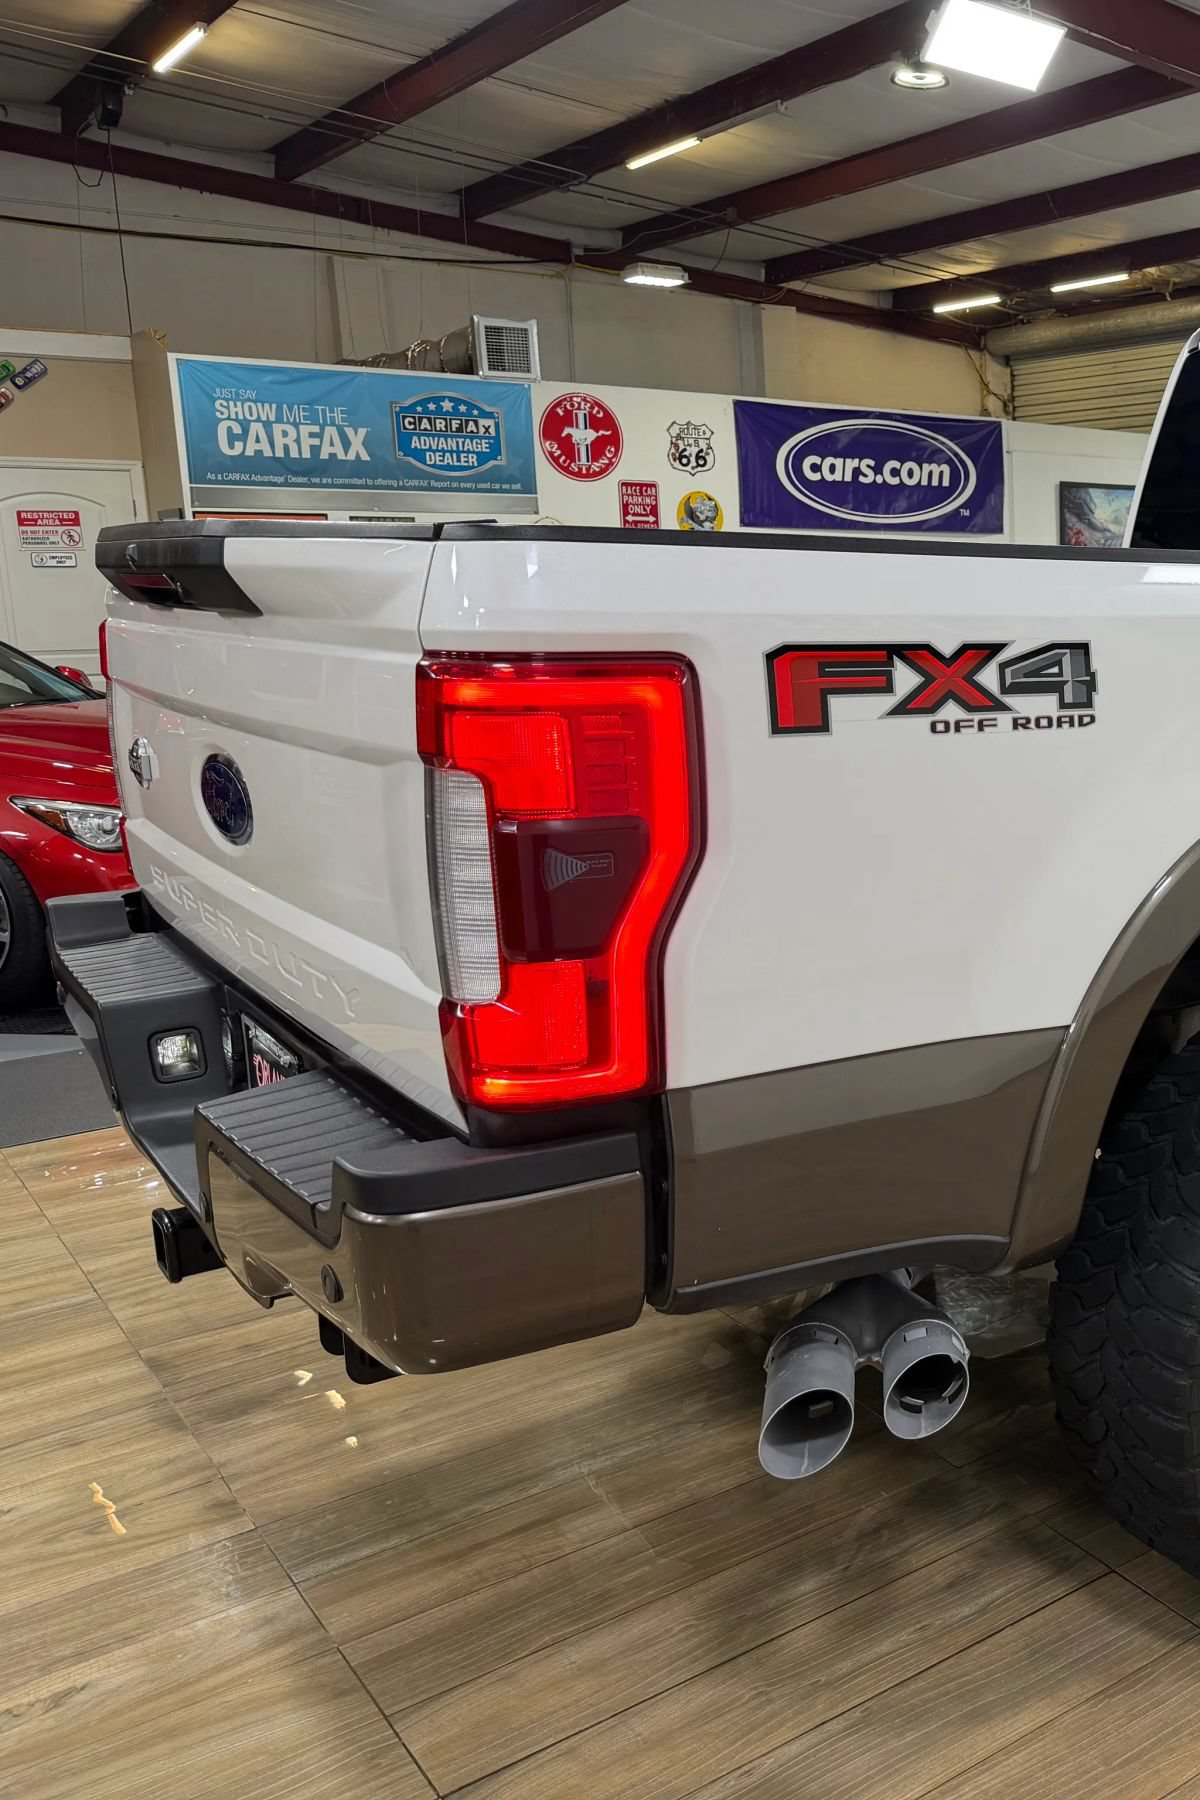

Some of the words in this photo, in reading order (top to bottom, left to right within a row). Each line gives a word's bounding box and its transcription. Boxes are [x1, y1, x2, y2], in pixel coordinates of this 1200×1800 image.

[214, 388, 236, 399] JUST
[239, 390, 257, 400] SAY
[215, 400, 277, 421] SHOW
[282, 404, 311, 423] ME
[314, 405, 349, 425] THE
[555, 400, 604, 418] FORD
[404, 417, 491, 435] CARFAX
[679, 427, 701, 436] ROUTE
[217, 420, 371, 461] CARFAX
[411, 436, 490, 452] ADVANTAGE
[426, 452, 478, 466] DEALER
[545, 440, 615, 474] MUSTANG
[802, 455, 950, 487] cars.com
[207, 472, 216, 480] As
[223, 472, 250, 481] CARFAX
[334, 477, 366, 485] committed
[374, 478, 398, 487] offering
[430, 480, 450, 488] Report
[460, 482, 476, 490] every
[622, 486, 641, 495] RACE
[643, 487, 656, 496] CAR
[623, 495, 656, 505] PARKING
[628, 505, 652, 514] ONLY
[763, 641, 1098, 737] FX4
[930, 716, 998, 734] OFF
[1011, 713, 1096, 731] ROAD
